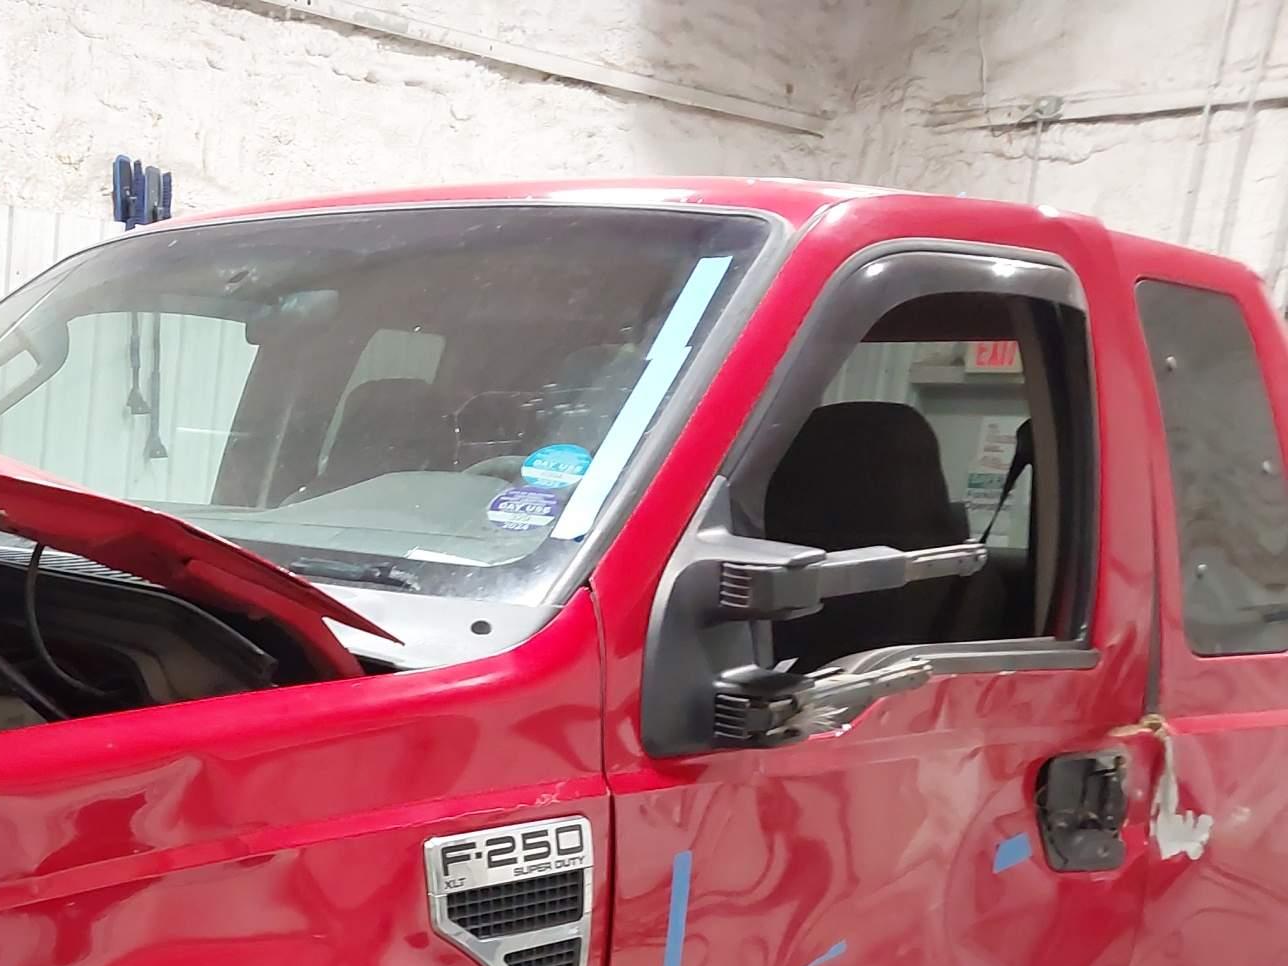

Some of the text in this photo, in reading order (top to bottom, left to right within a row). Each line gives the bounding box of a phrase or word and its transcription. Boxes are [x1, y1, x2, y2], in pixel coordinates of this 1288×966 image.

[498, 502, 552, 514] DAY USE
[441, 824, 584, 877] F-250
[513, 856, 585, 877] SUPER DUTY
[444, 877, 467, 890] XLT
